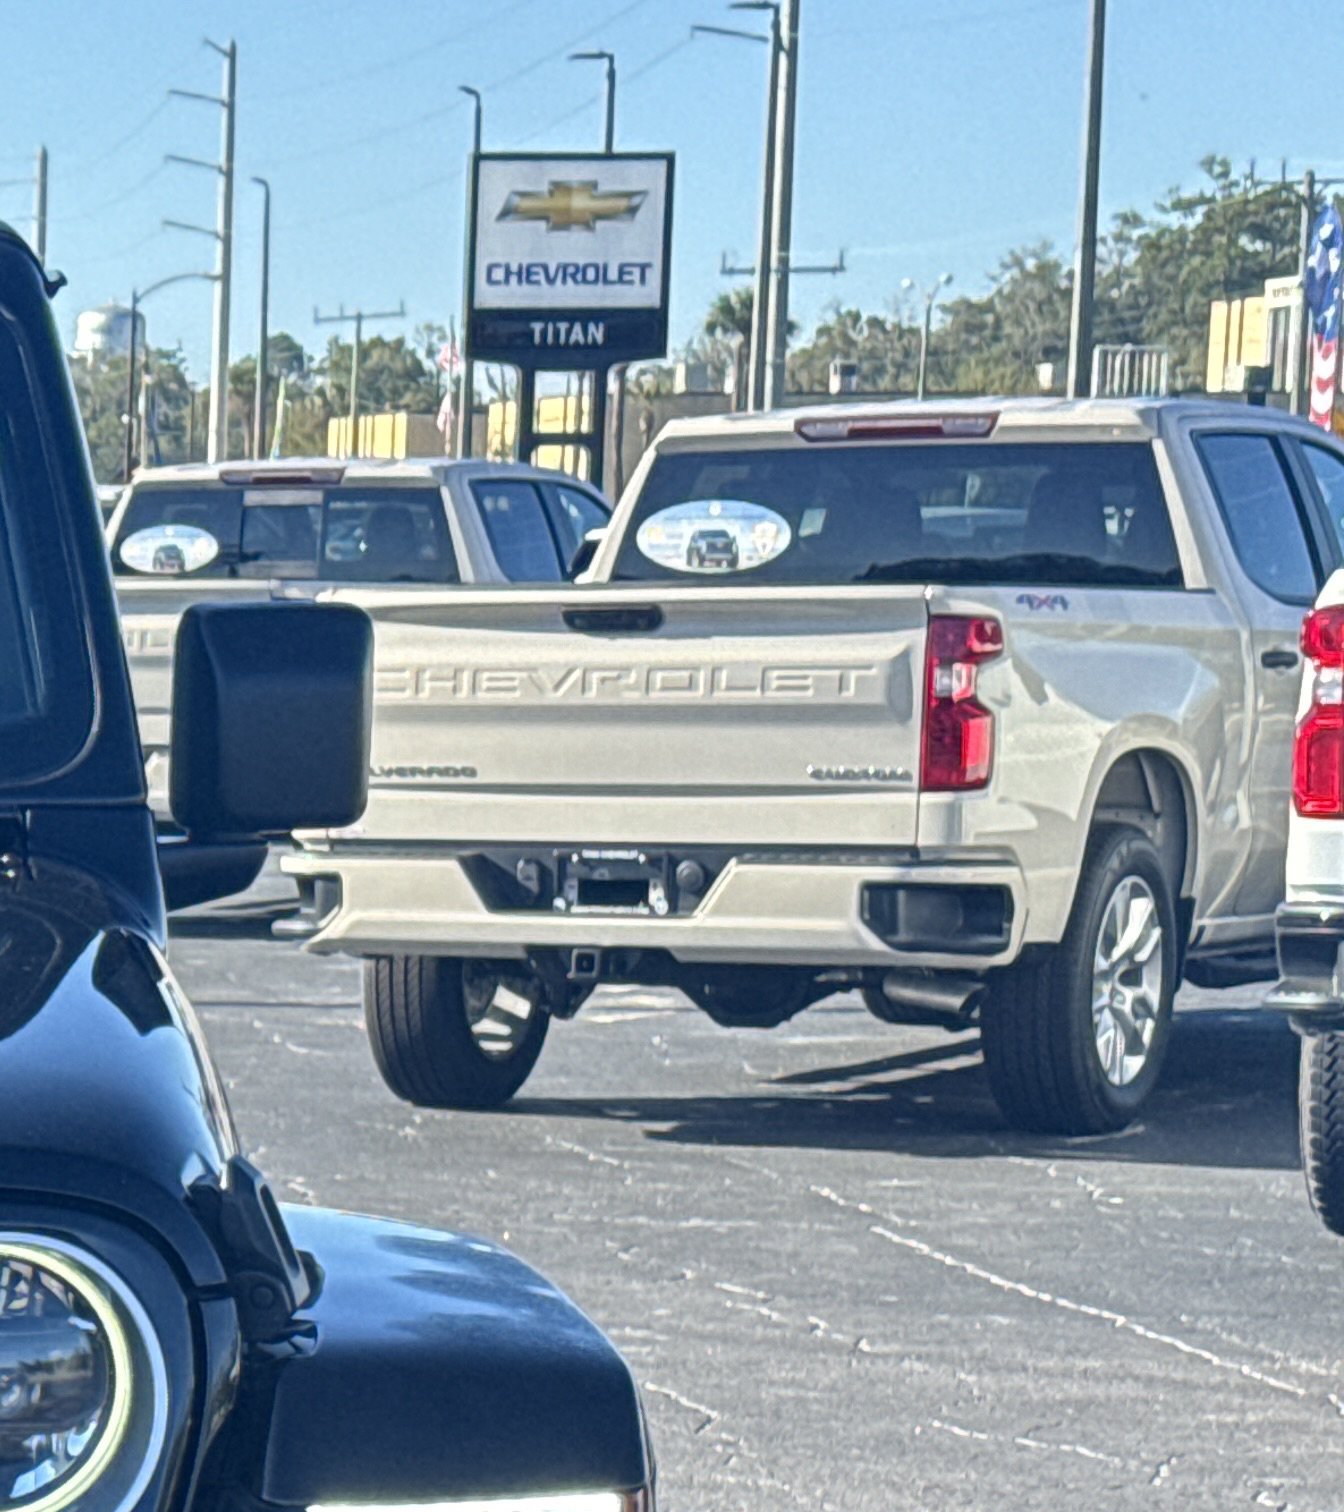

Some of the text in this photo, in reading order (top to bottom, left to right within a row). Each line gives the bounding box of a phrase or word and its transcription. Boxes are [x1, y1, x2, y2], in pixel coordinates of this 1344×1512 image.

[486, 263, 652, 286] CHEVROLET
[529, 321, 605, 346] TITAN
[369, 766, 478, 779] LVERADO
